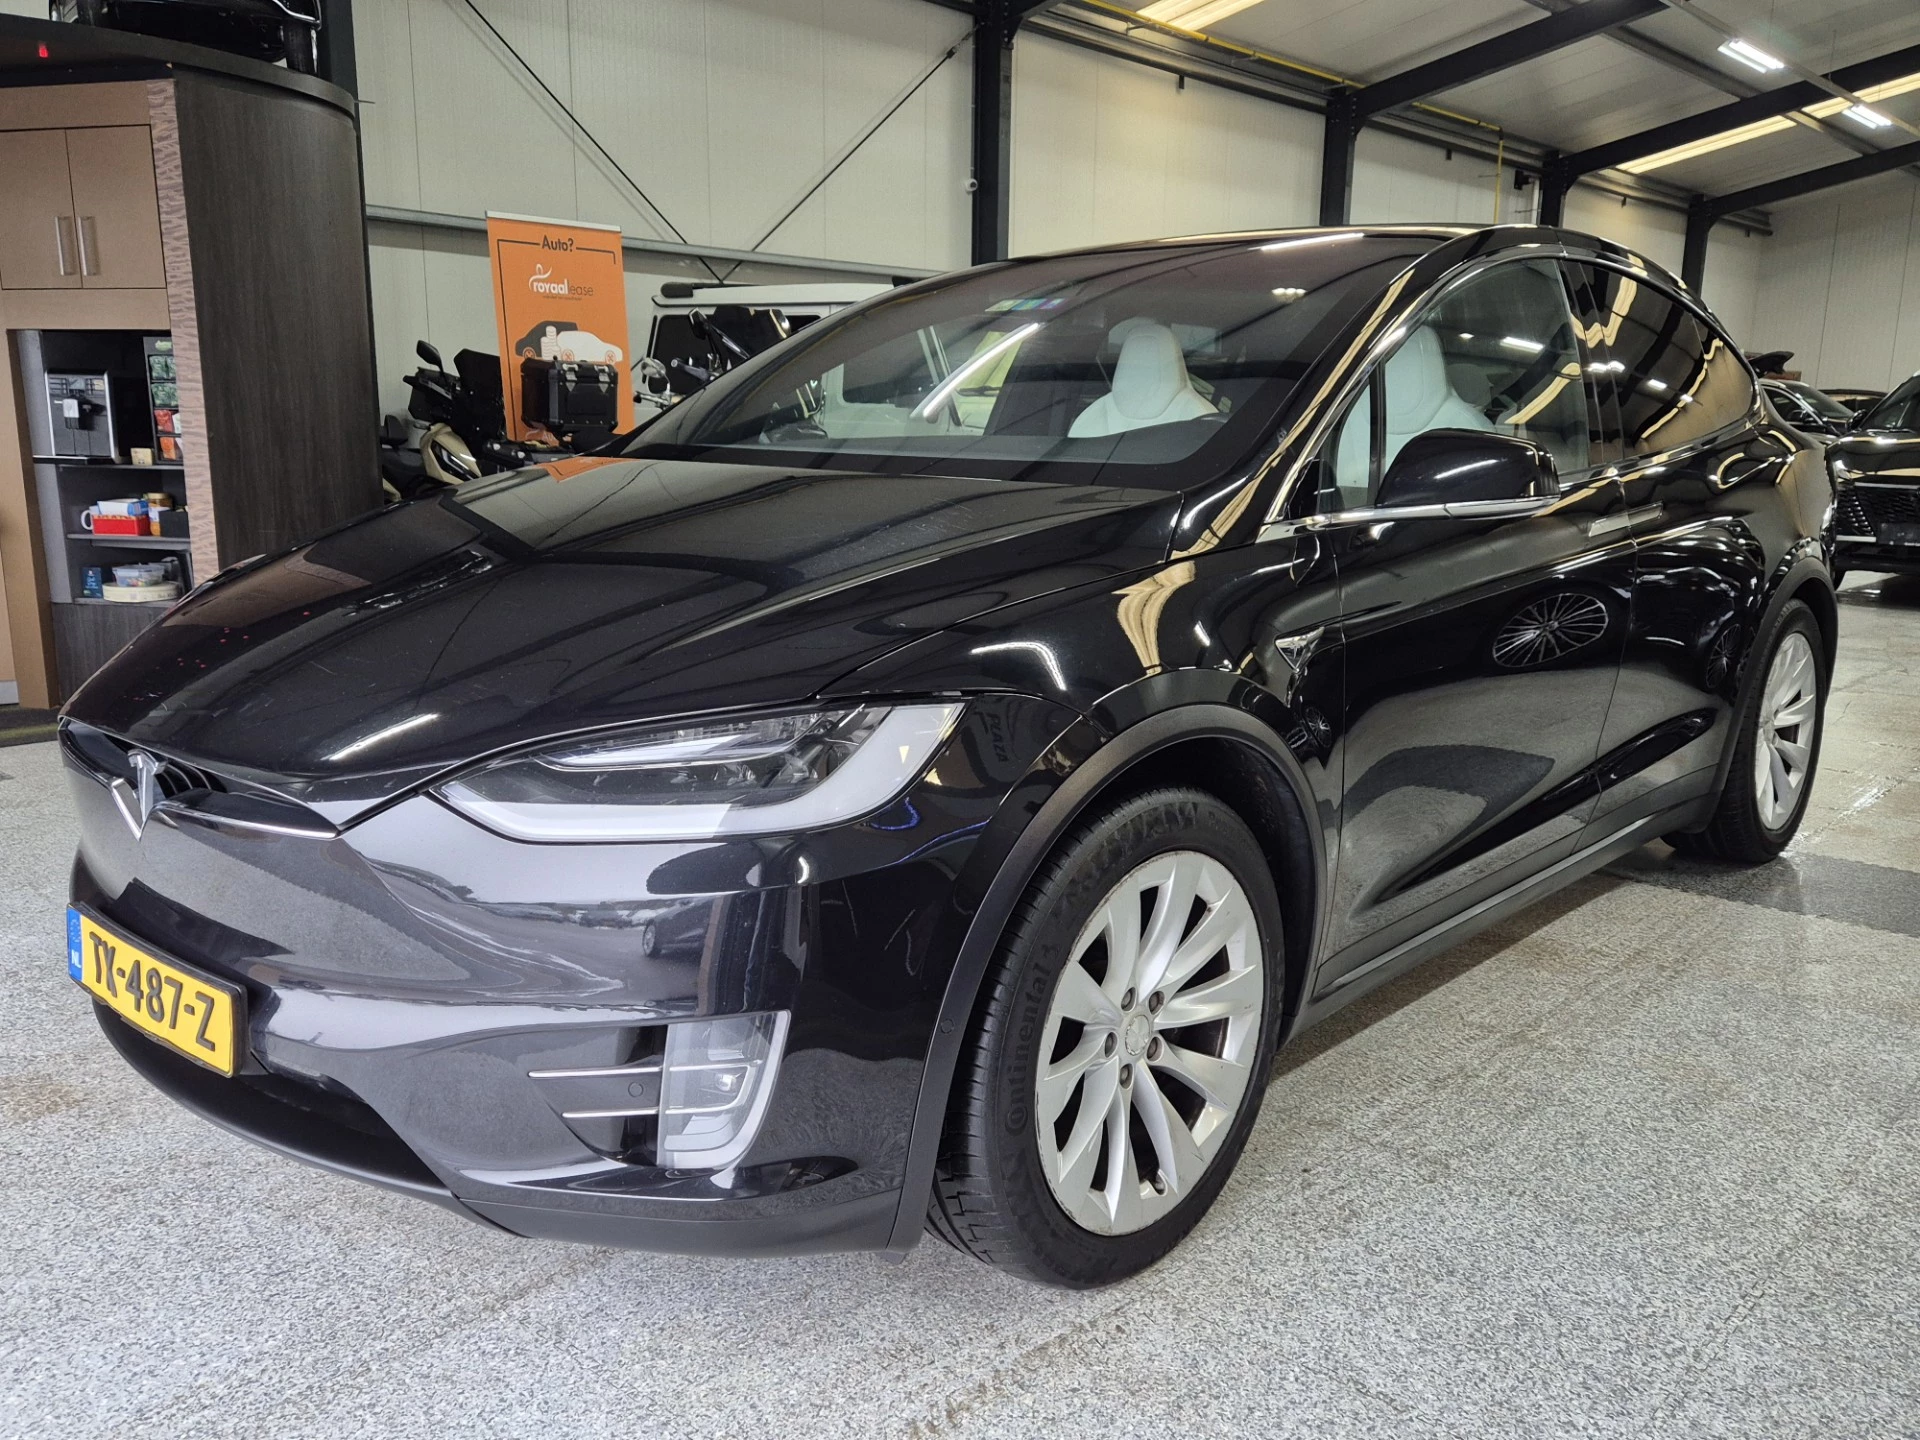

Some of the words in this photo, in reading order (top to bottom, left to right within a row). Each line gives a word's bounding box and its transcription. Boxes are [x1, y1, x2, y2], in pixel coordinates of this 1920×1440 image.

[541, 234, 574, 252] Auto?
[71, 950, 82, 969] NL
[89, 931, 216, 1052] TX-487-Z
[1005, 963, 1050, 1137] Continental
